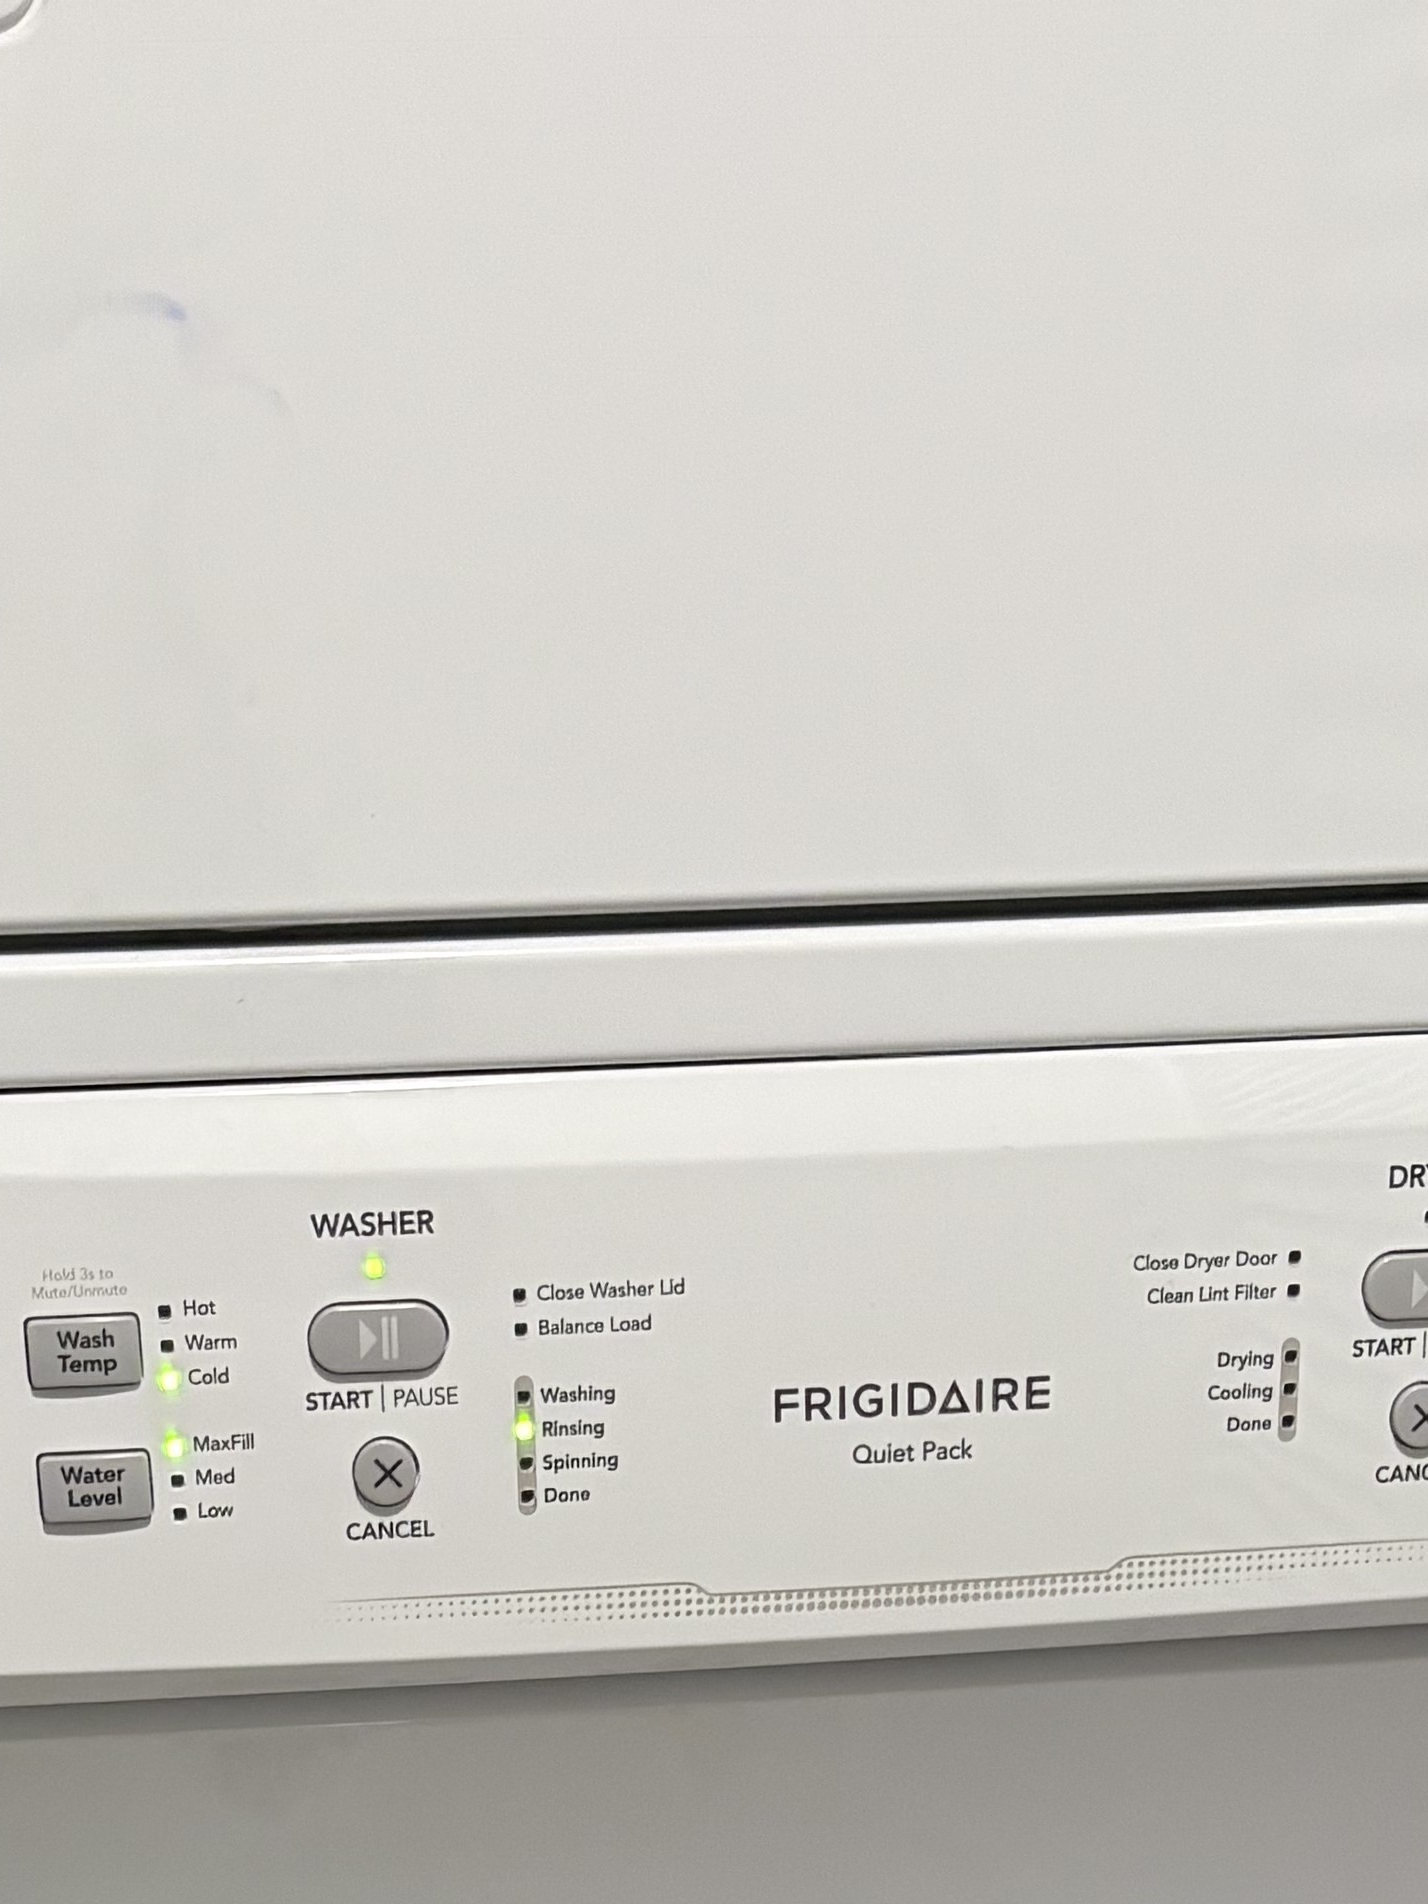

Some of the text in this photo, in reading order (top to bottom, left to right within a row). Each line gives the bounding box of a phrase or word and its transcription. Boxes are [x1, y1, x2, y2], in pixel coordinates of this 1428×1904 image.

[310, 1210, 434, 1239] WASHER
[1134, 1251, 1278, 1272] Close Dryer Door
[42, 1268, 113, 1281] Hold 3s to
[31, 1285, 127, 1300] Mute/Unmute
[537, 1277, 685, 1301] Close Washer Lid
[1148, 1283, 1277, 1304] Clean Lint Filter
[184, 1300, 216, 1316] Hot
[539, 1313, 651, 1335] Balance Load
[57, 1329, 115, 1350] Wash
[185, 1335, 237, 1350] Warm
[1353, 1337, 1416, 1357] START
[58, 1355, 117, 1375] Temp
[1218, 1351, 1274, 1371] Drying
[188, 1367, 229, 1384] Cold
[306, 1387, 458, 1412] START PAUSE
[541, 1385, 615, 1404] Washing
[774, 1376, 1050, 1422] FRIGIDAIRE
[1208, 1383, 1273, 1402] Cooling
[543, 1420, 605, 1438] Rinsing
[1227, 1417, 1271, 1432] Done
[194, 1433, 254, 1452] MaxFill
[853, 1438, 972, 1464] Quiet Pack
[543, 1453, 618, 1473] Spinning
[61, 1466, 125, 1484] Water
[196, 1467, 235, 1485] Med
[68, 1486, 122, 1507] Level
[544, 1488, 590, 1503] Done
[198, 1503, 233, 1518] Low
[346, 1519, 434, 1541] CANCEL
